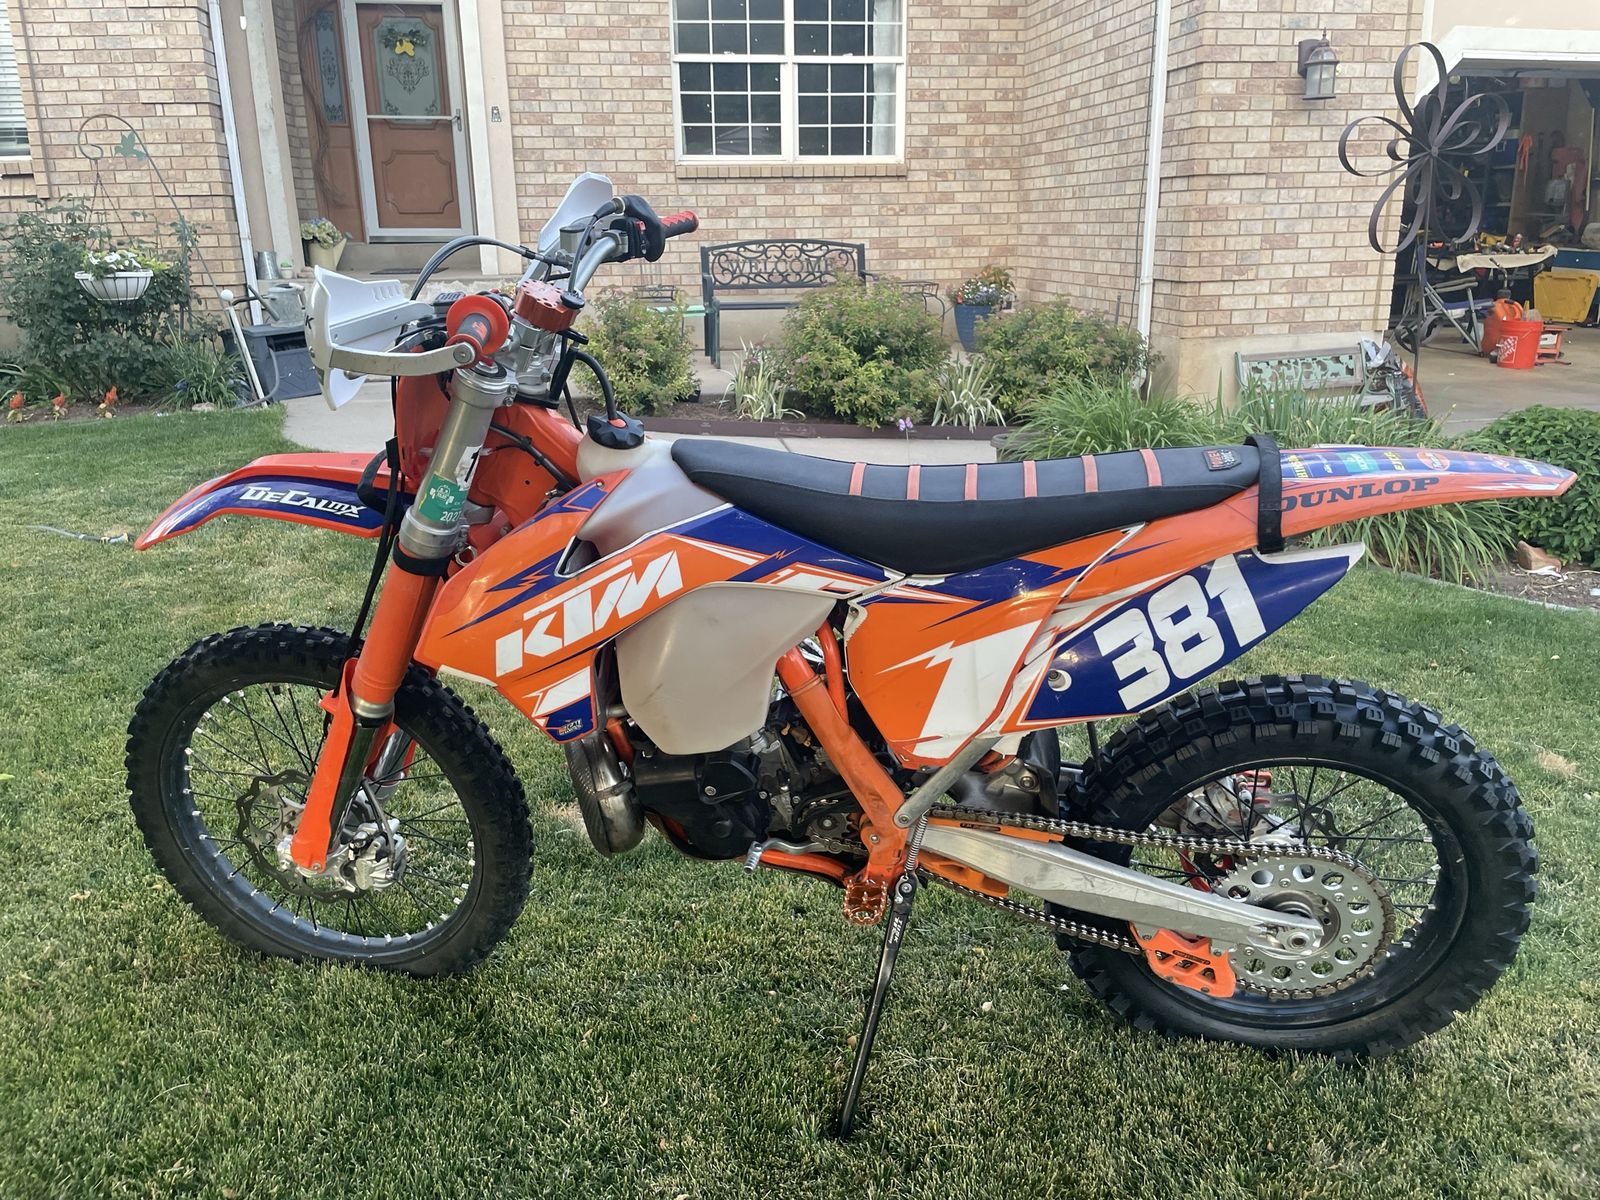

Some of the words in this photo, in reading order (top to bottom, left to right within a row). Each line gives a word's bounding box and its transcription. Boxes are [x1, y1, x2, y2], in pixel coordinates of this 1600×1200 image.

[729, 258, 835, 274] WELCOME
[1280, 477, 1440, 513] DUNLOP
[495, 550, 684, 677] KTM
[1093, 553, 1267, 711] 381
